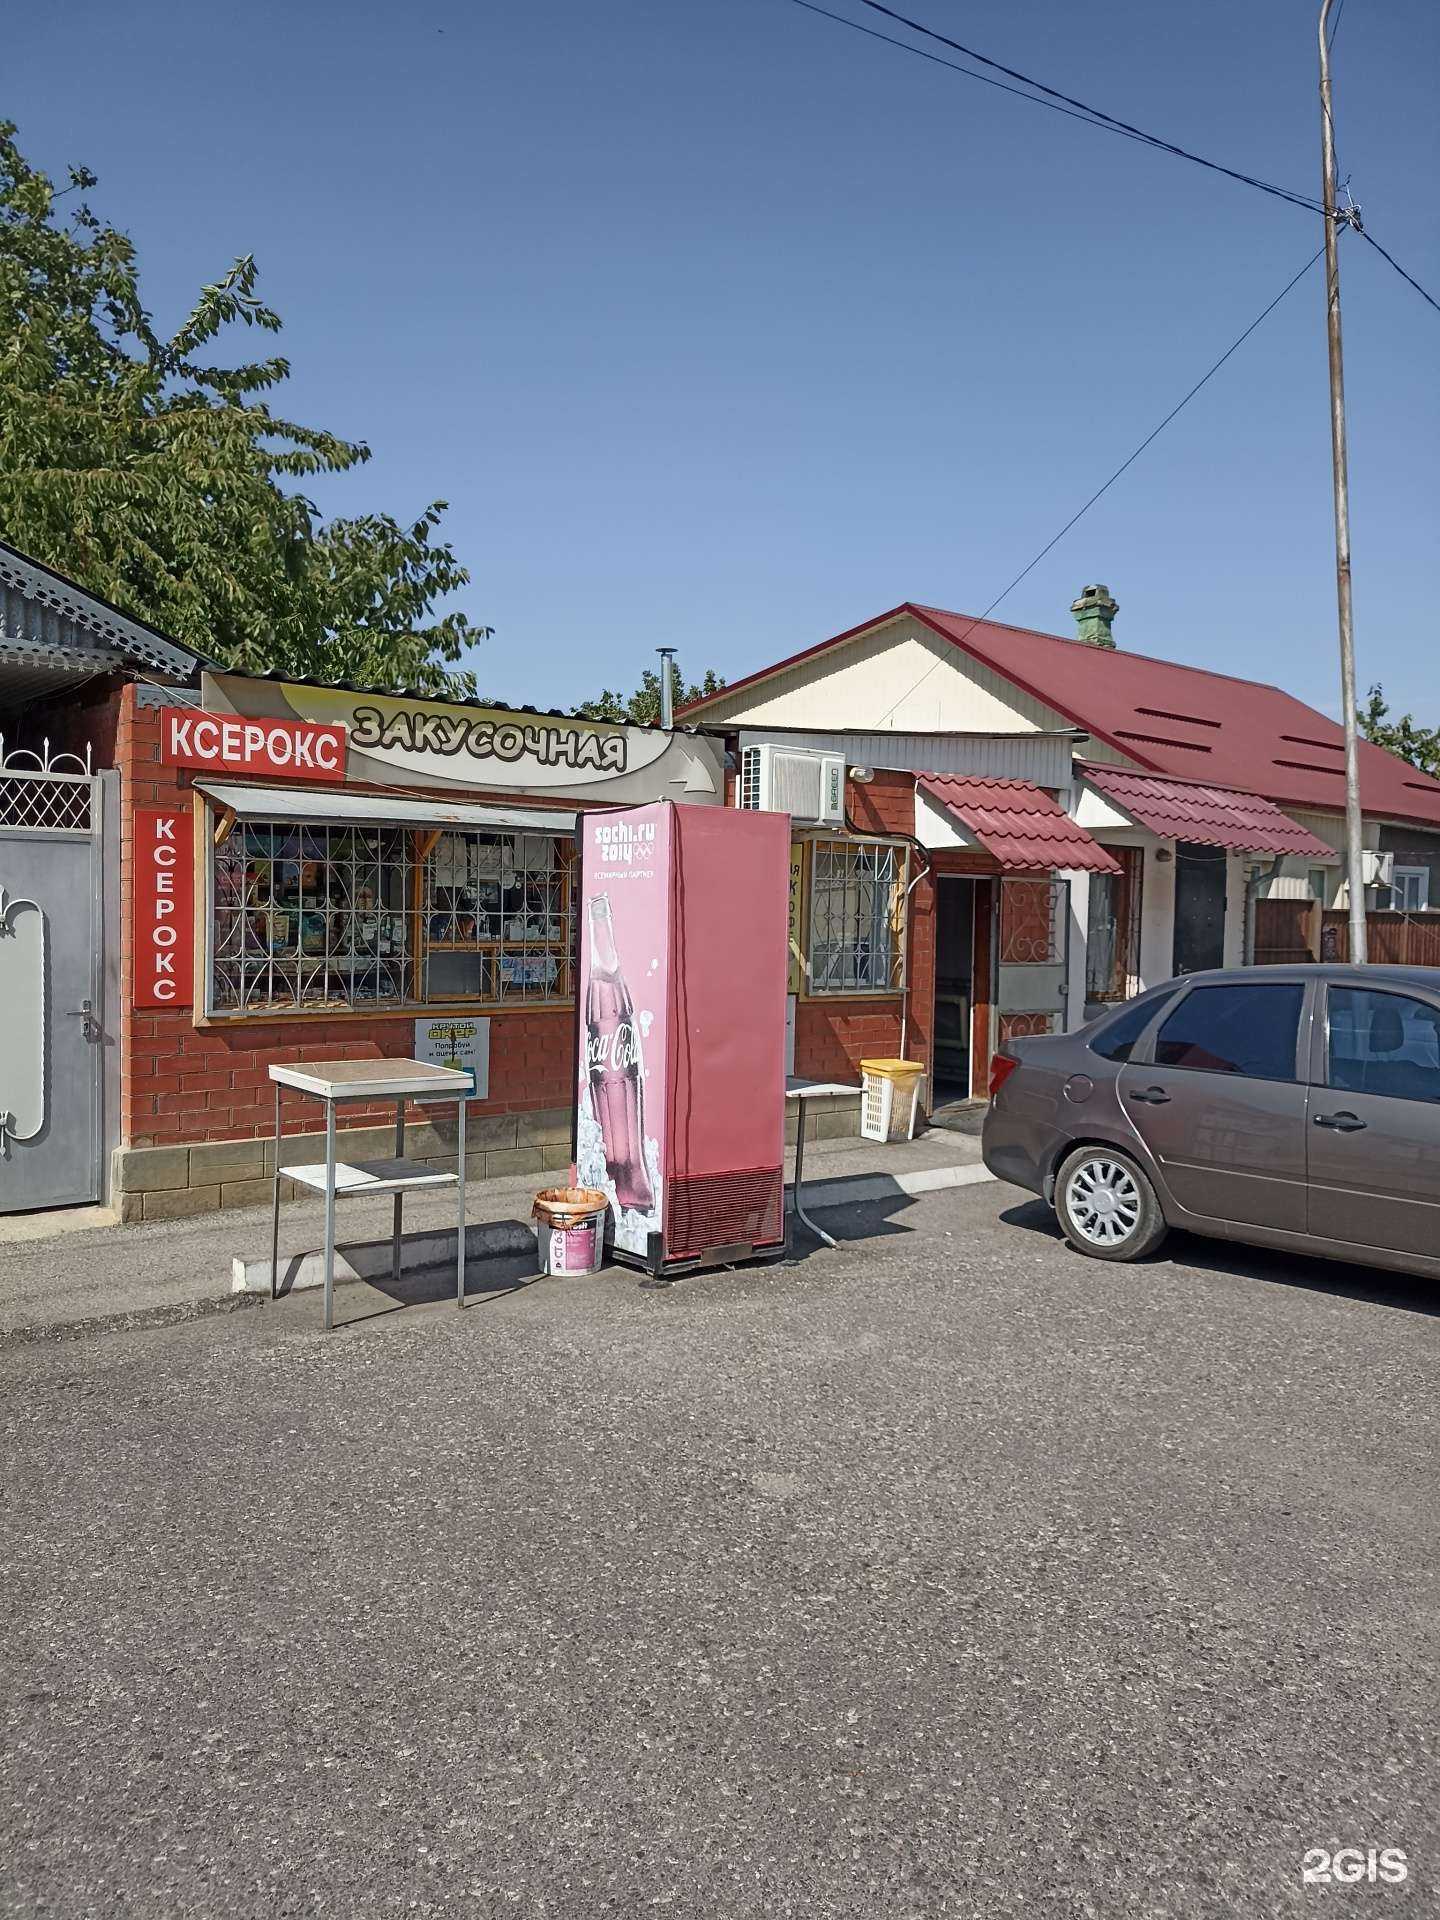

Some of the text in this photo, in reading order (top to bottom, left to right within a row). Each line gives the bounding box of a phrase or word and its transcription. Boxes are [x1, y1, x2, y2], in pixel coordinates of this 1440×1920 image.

[171, 717, 338, 770] КСЕРОКС
[350, 706, 628, 772] ЗАКУСОЧНАЯ
[594, 820, 655, 844] sochi.ru
[601, 843, 633, 865] 2014
[152, 818, 177, 1000] КСЕРОКС
[432, 1022, 473, 1030] КРУТОЙ
